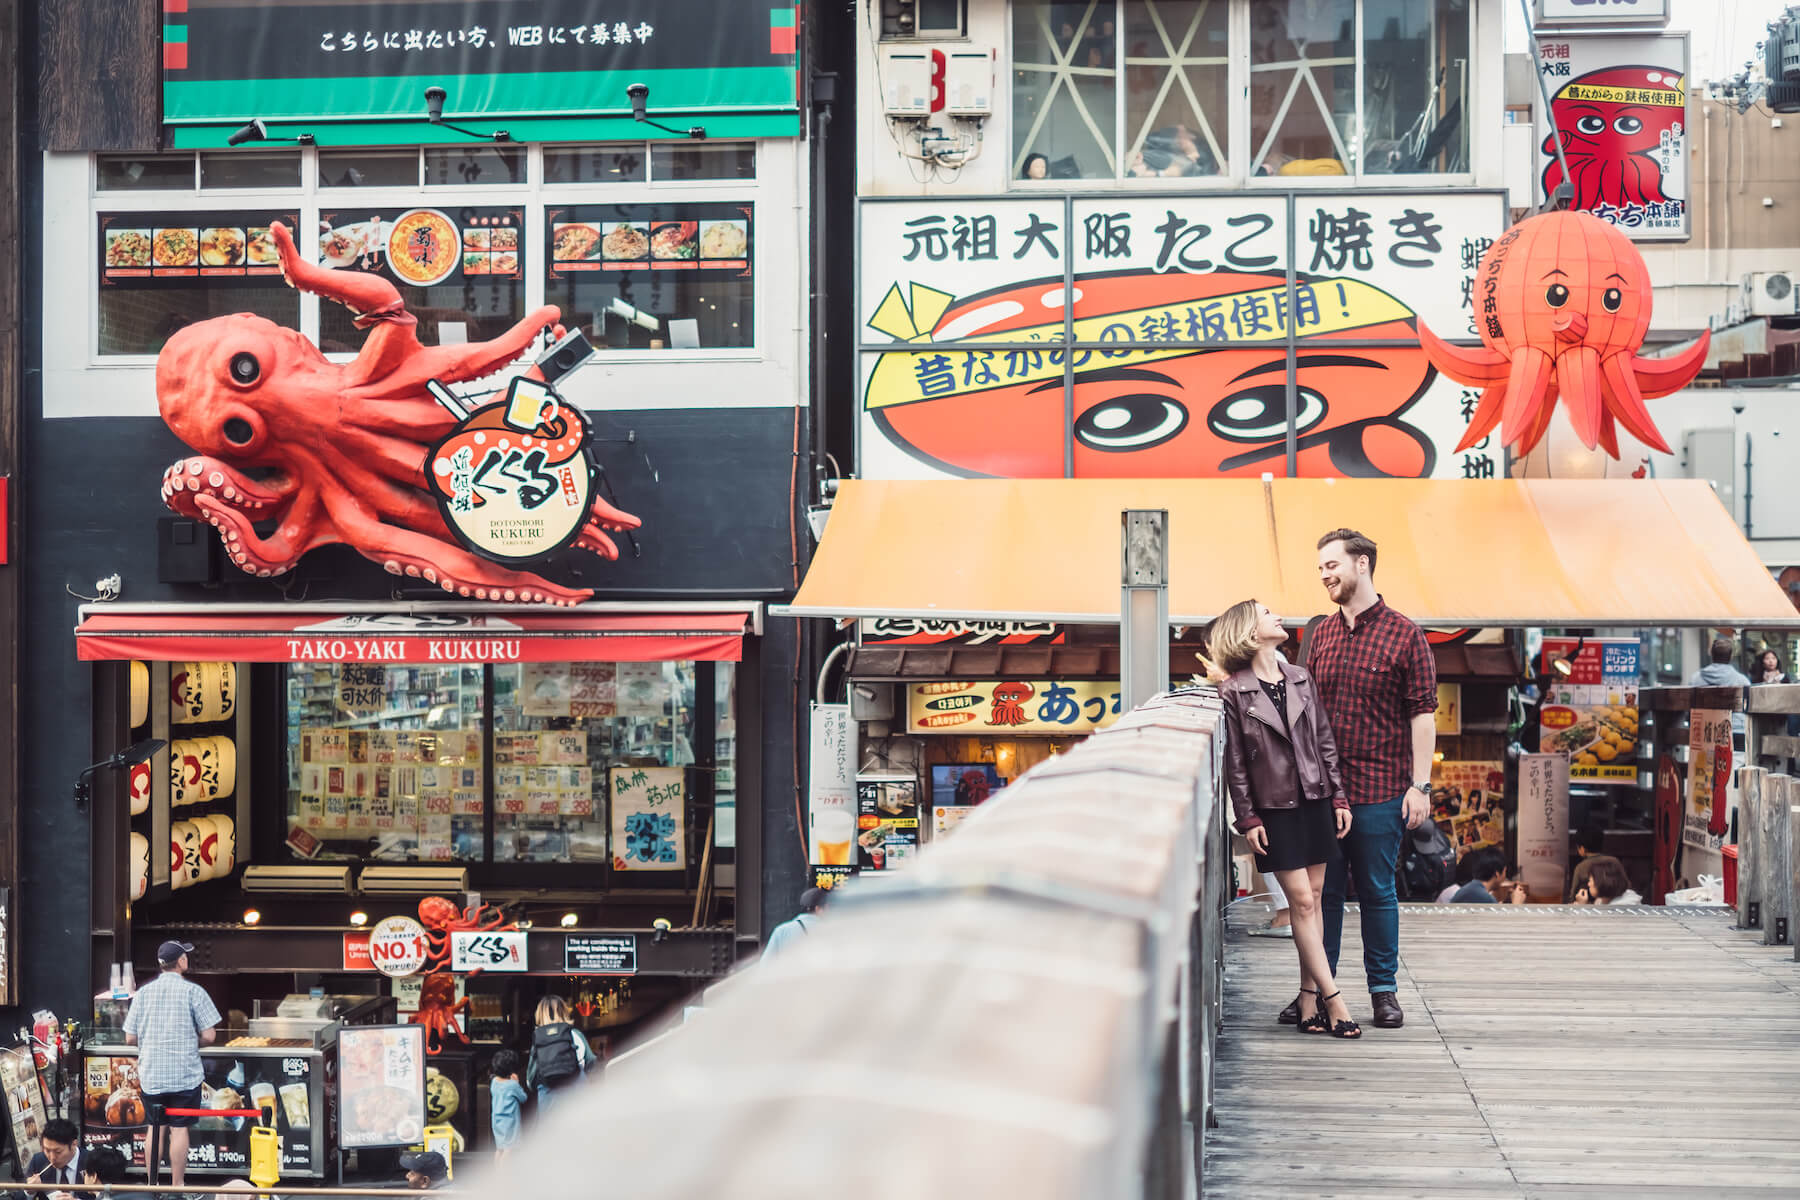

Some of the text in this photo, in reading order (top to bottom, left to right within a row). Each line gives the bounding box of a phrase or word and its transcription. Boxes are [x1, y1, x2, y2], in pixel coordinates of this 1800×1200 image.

[1540, 43, 1570, 59] 元祖
[1542, 62, 1571, 76] 大阪
[1592, 202, 1681, 228] ちち本舗
[472, 450, 559, 510] くくる
[490, 519, 544, 527] DOTONBORI
[490, 528, 545, 539] KUKURU
[287, 640, 521, 660] TAKO-YAKI KUKURU
[373, 937, 424, 960] NO.1
